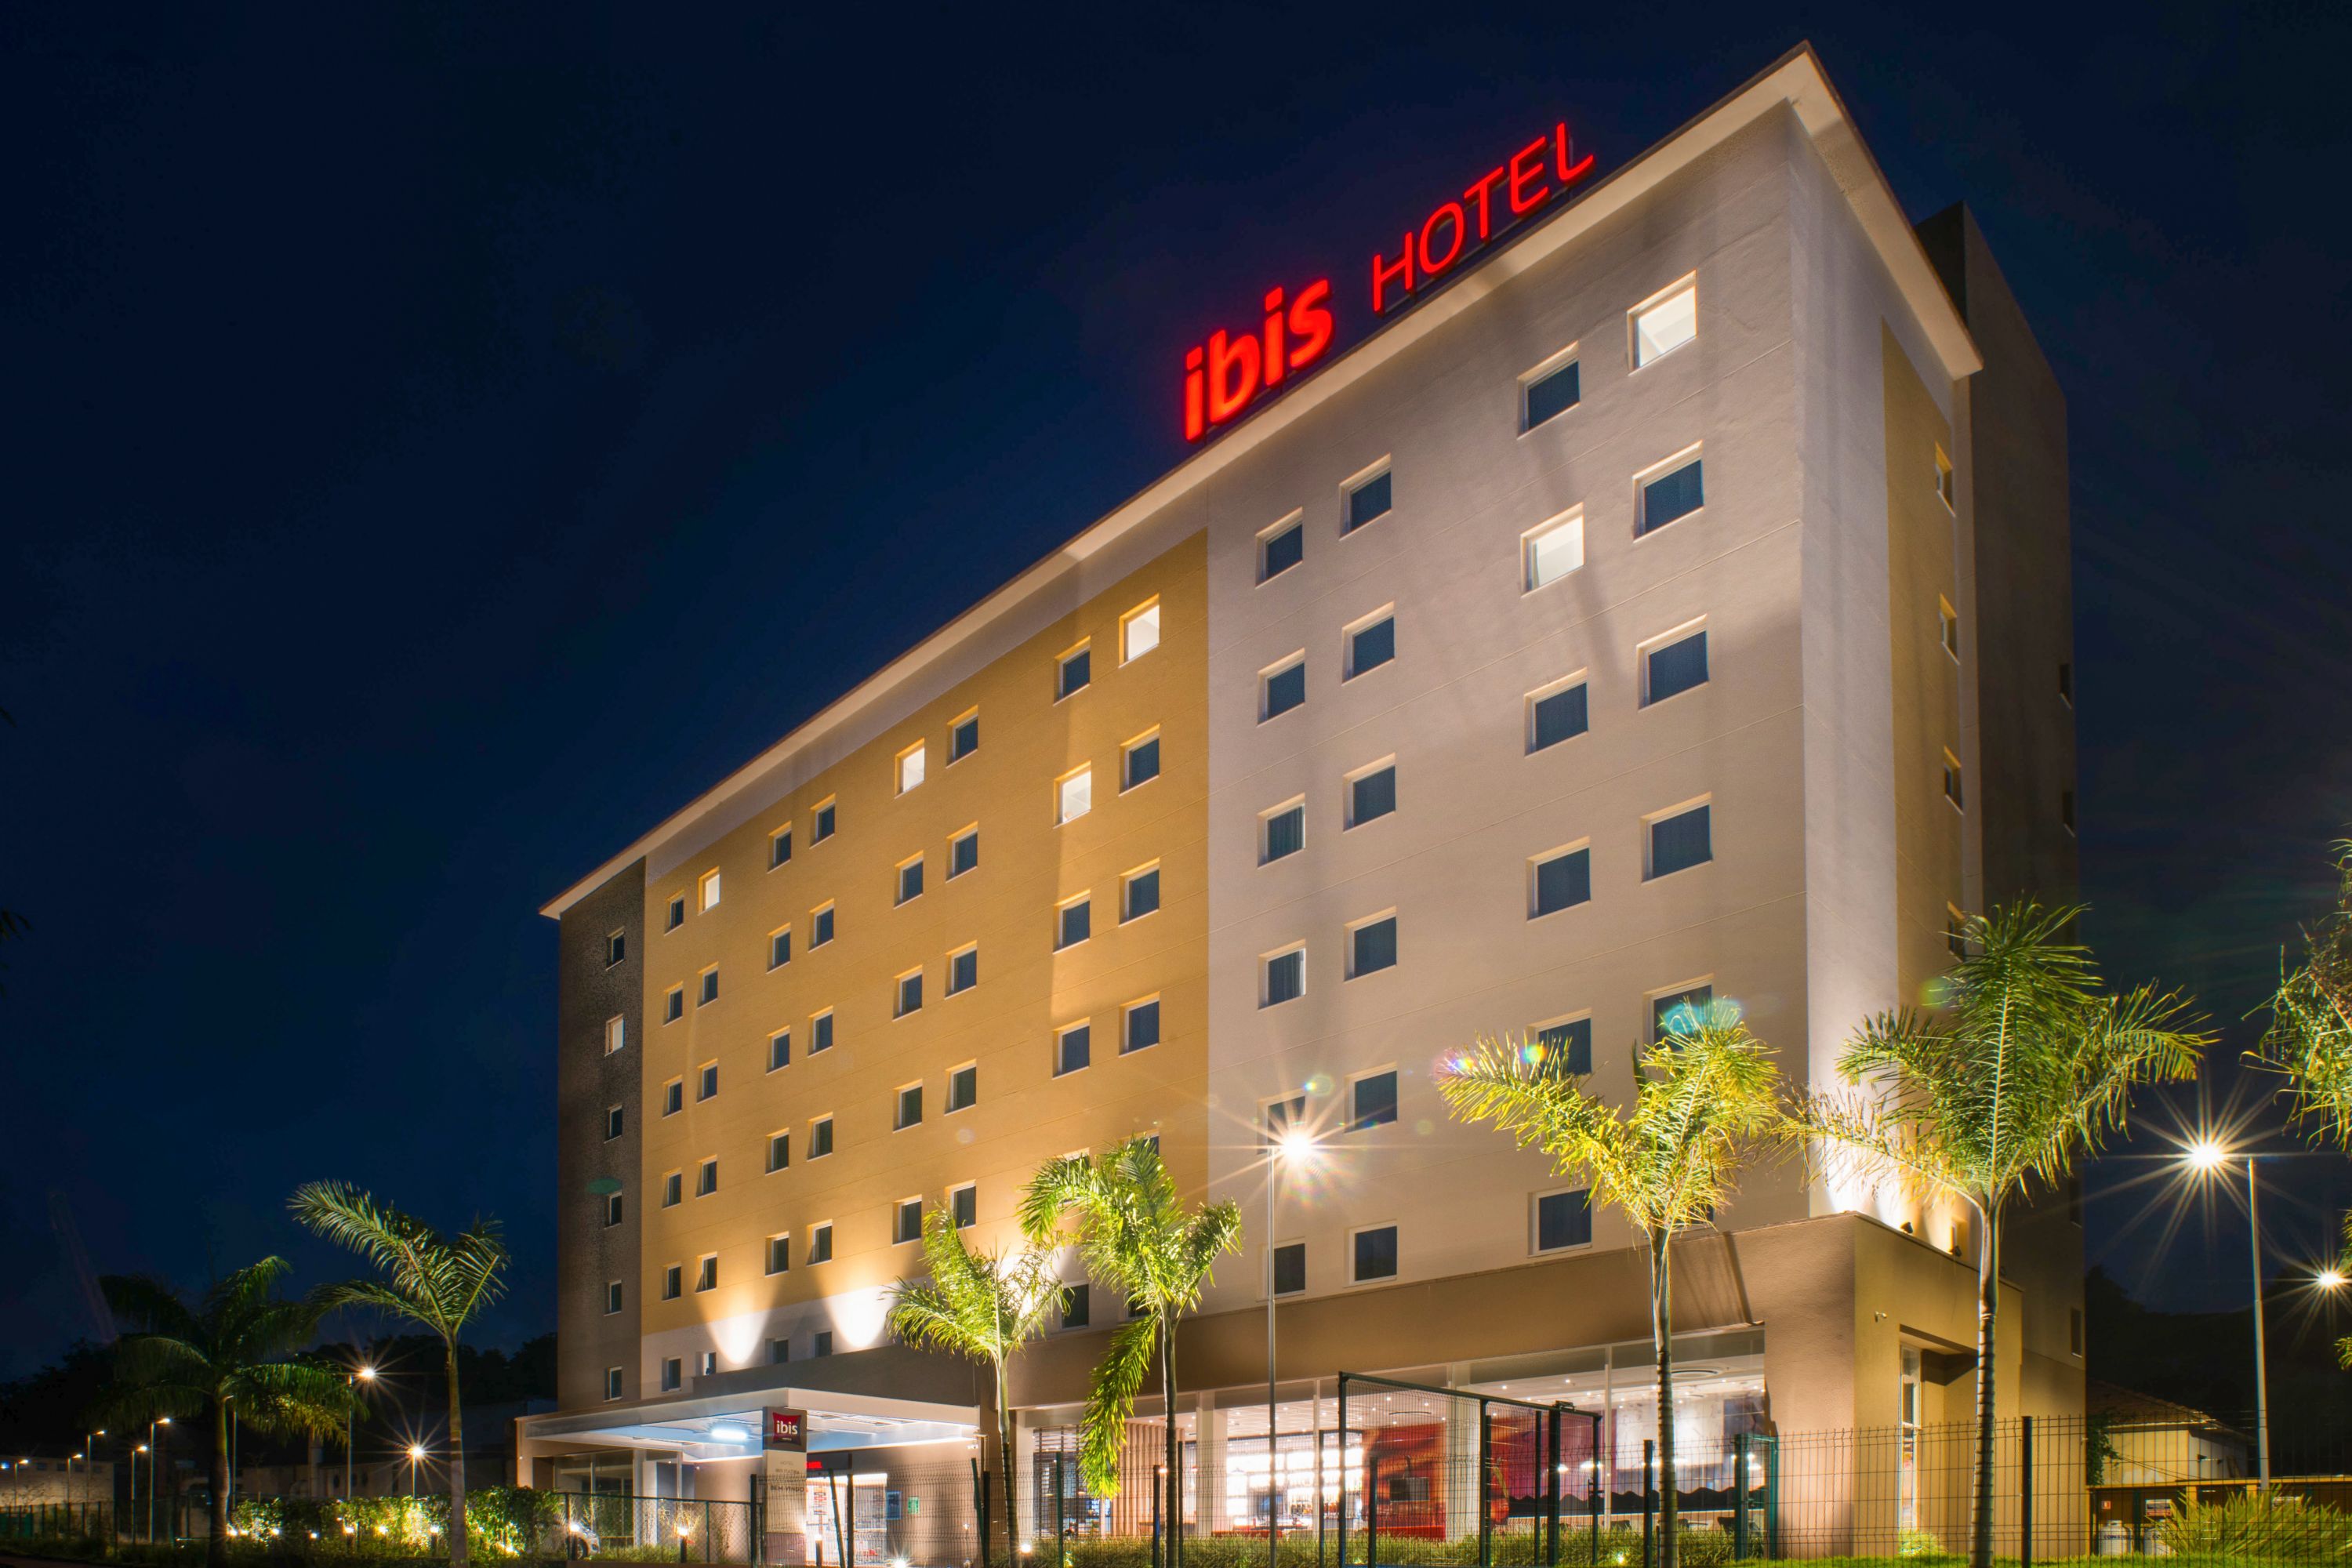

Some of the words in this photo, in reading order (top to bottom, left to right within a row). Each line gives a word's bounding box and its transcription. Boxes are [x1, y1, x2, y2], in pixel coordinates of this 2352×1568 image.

[1185, 279, 1332, 441] ibis
[1374, 122, 1594, 312] HOTEL
[776, 1420, 798, 1435] ibis
